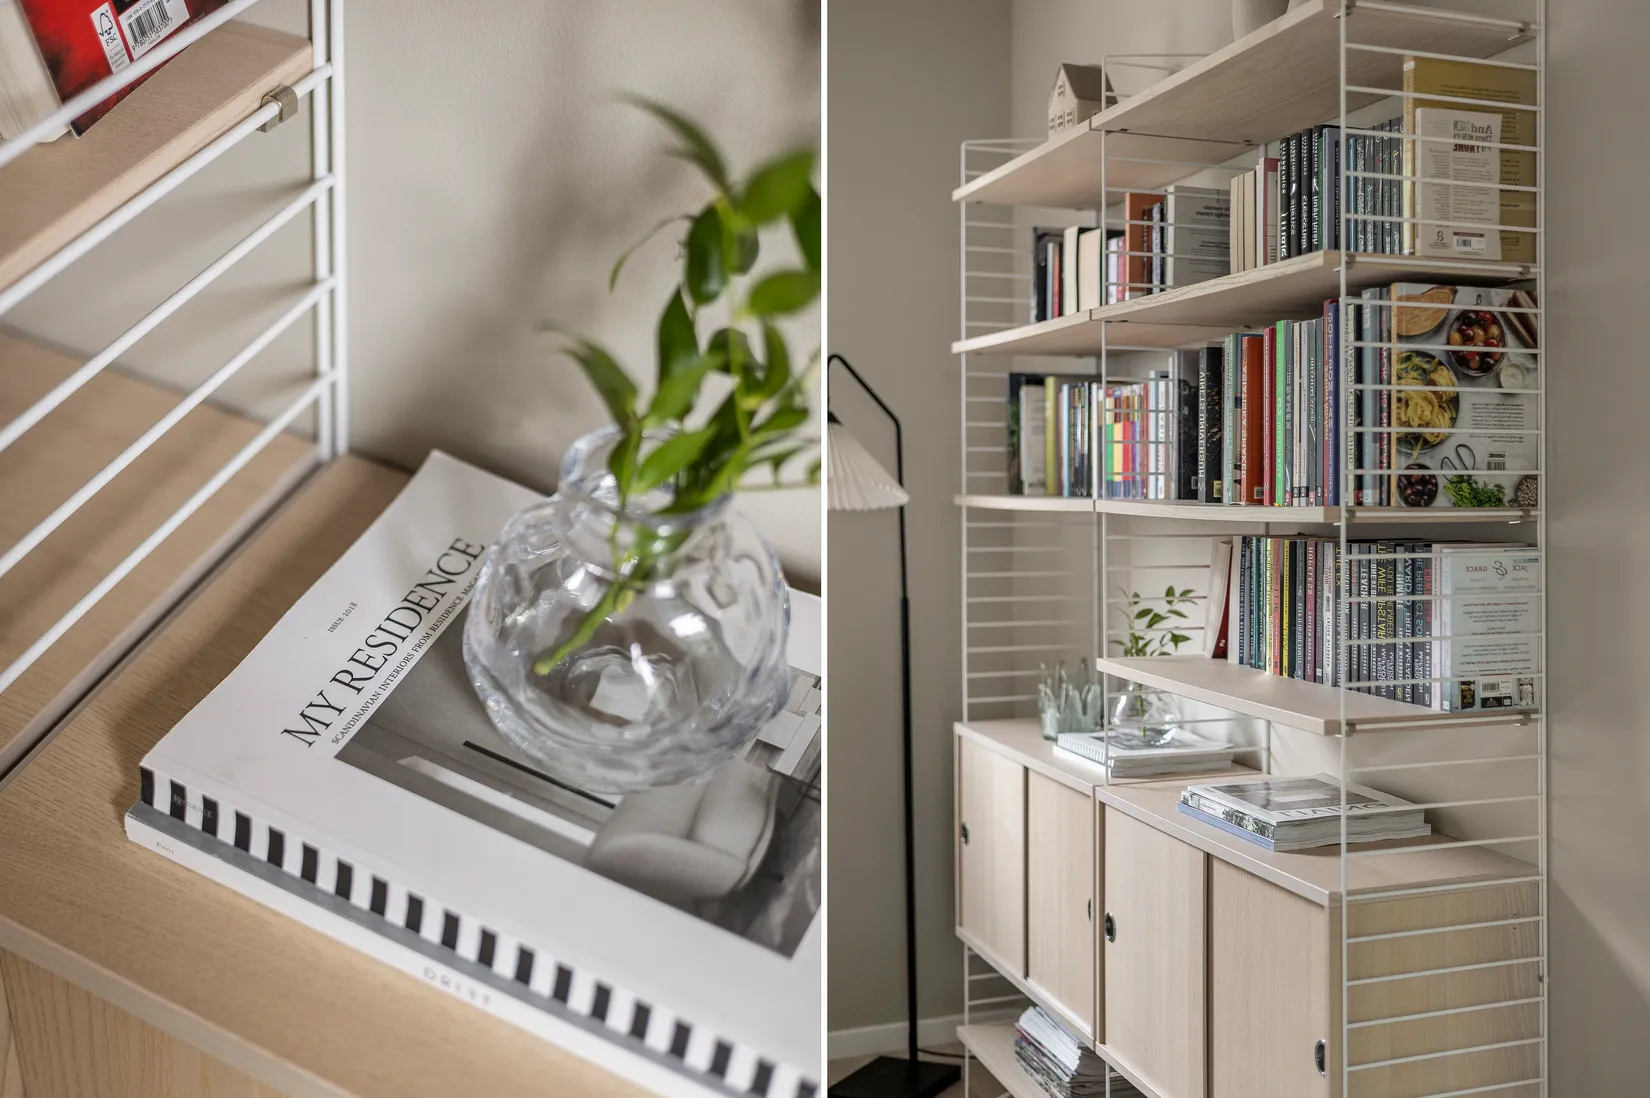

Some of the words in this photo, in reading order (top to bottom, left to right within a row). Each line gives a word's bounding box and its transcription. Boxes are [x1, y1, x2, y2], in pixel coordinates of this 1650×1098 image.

[105, 32, 119, 47] FSC
[327, 617, 344, 633] ISSUE
[342, 601, 359, 618] 2018
[280, 690, 347, 748] MY
[329, 538, 485, 695] RESIDENCE
[331, 690, 382, 745] SCANDINAVIAN
[378, 652, 416, 693] INTERIORS
[411, 632, 433, 653] FROM
[431, 595, 465, 633] RESIDENCE
[174, 794, 213, 819] RESIDENCE
